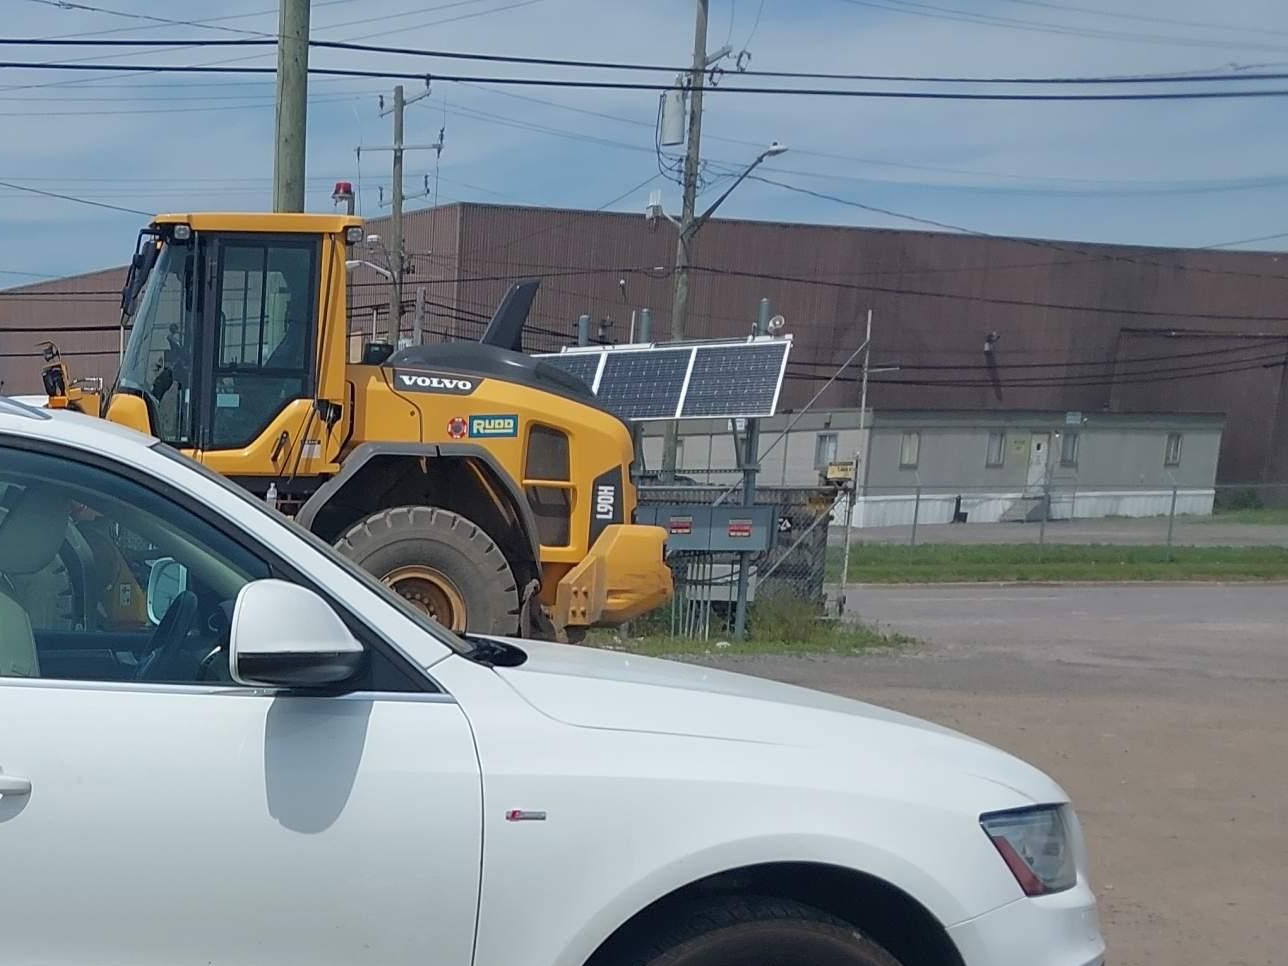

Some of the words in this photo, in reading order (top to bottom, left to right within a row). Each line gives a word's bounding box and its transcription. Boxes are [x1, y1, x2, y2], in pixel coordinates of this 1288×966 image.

[399, 375, 472, 390] VOLVO
[473, 419, 514, 433] RUDD
[596, 485, 615, 520] L90H
